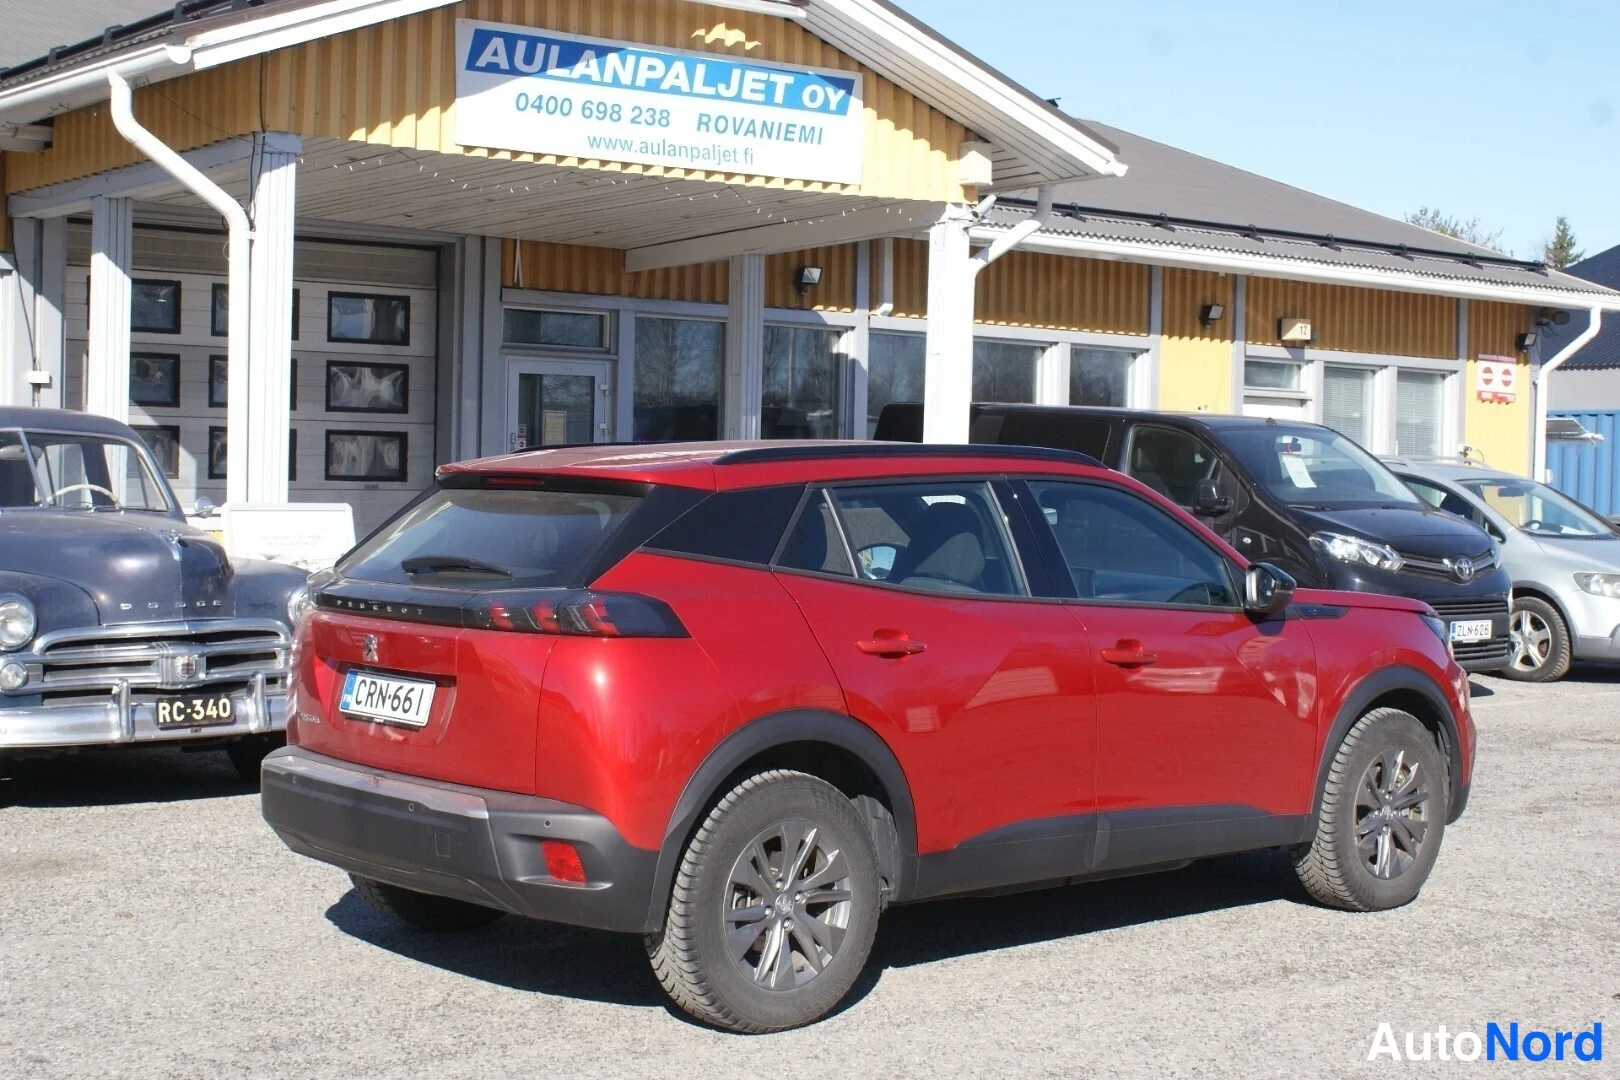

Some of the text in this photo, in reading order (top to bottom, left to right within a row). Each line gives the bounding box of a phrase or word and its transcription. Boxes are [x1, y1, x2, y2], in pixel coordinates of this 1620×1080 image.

[474, 37, 849, 111] AULANPALJET OY
[514, 92, 824, 145] 0400 698 238 ROVANIEMI
[119, 599, 222, 610] DODGE
[336, 600, 424, 616] PEUGEOT
[157, 697, 231, 723] RC-340
[355, 678, 425, 716] CRN-661
